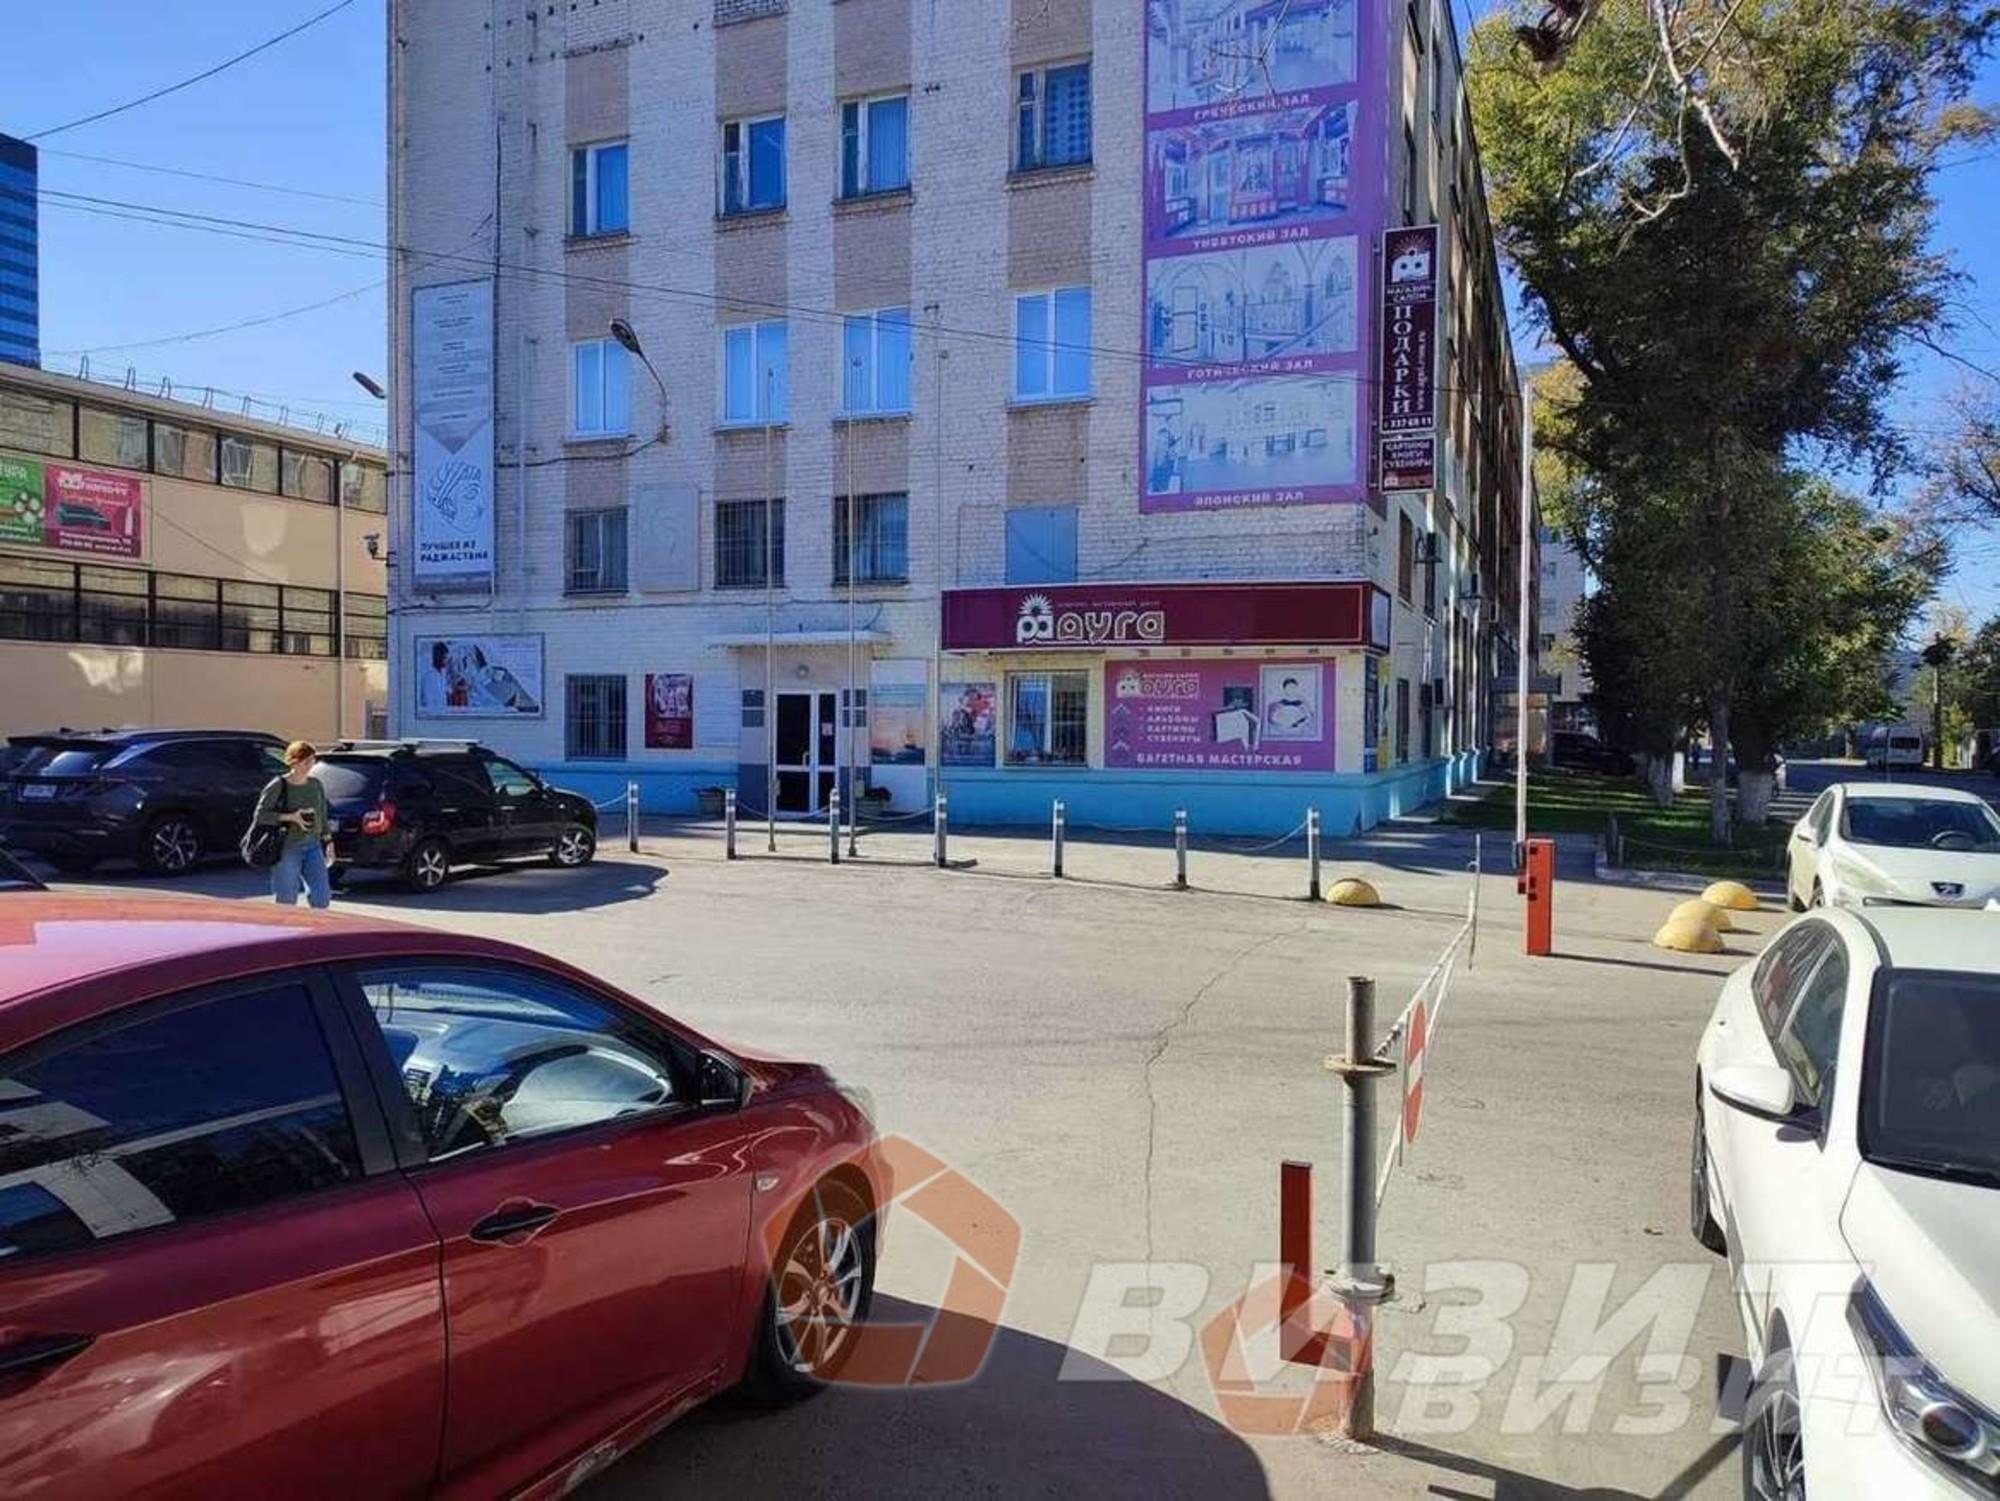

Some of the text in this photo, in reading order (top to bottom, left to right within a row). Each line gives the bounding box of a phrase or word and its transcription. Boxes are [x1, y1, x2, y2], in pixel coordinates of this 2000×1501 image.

[1280, 226, 1309, 238] ЗАЛ
[1286, 359, 1313, 370] ЗАЛ
[1393, 305, 1412, 414] ПОДАРКИ
[1276, 491, 1304, 502] ЗАЛ
[420, 551, 489, 563] РАДЖАСТАНА
[1137, 753, 1302, 766] БАГЕТНАЯ МАСТЕРСКАЯ
